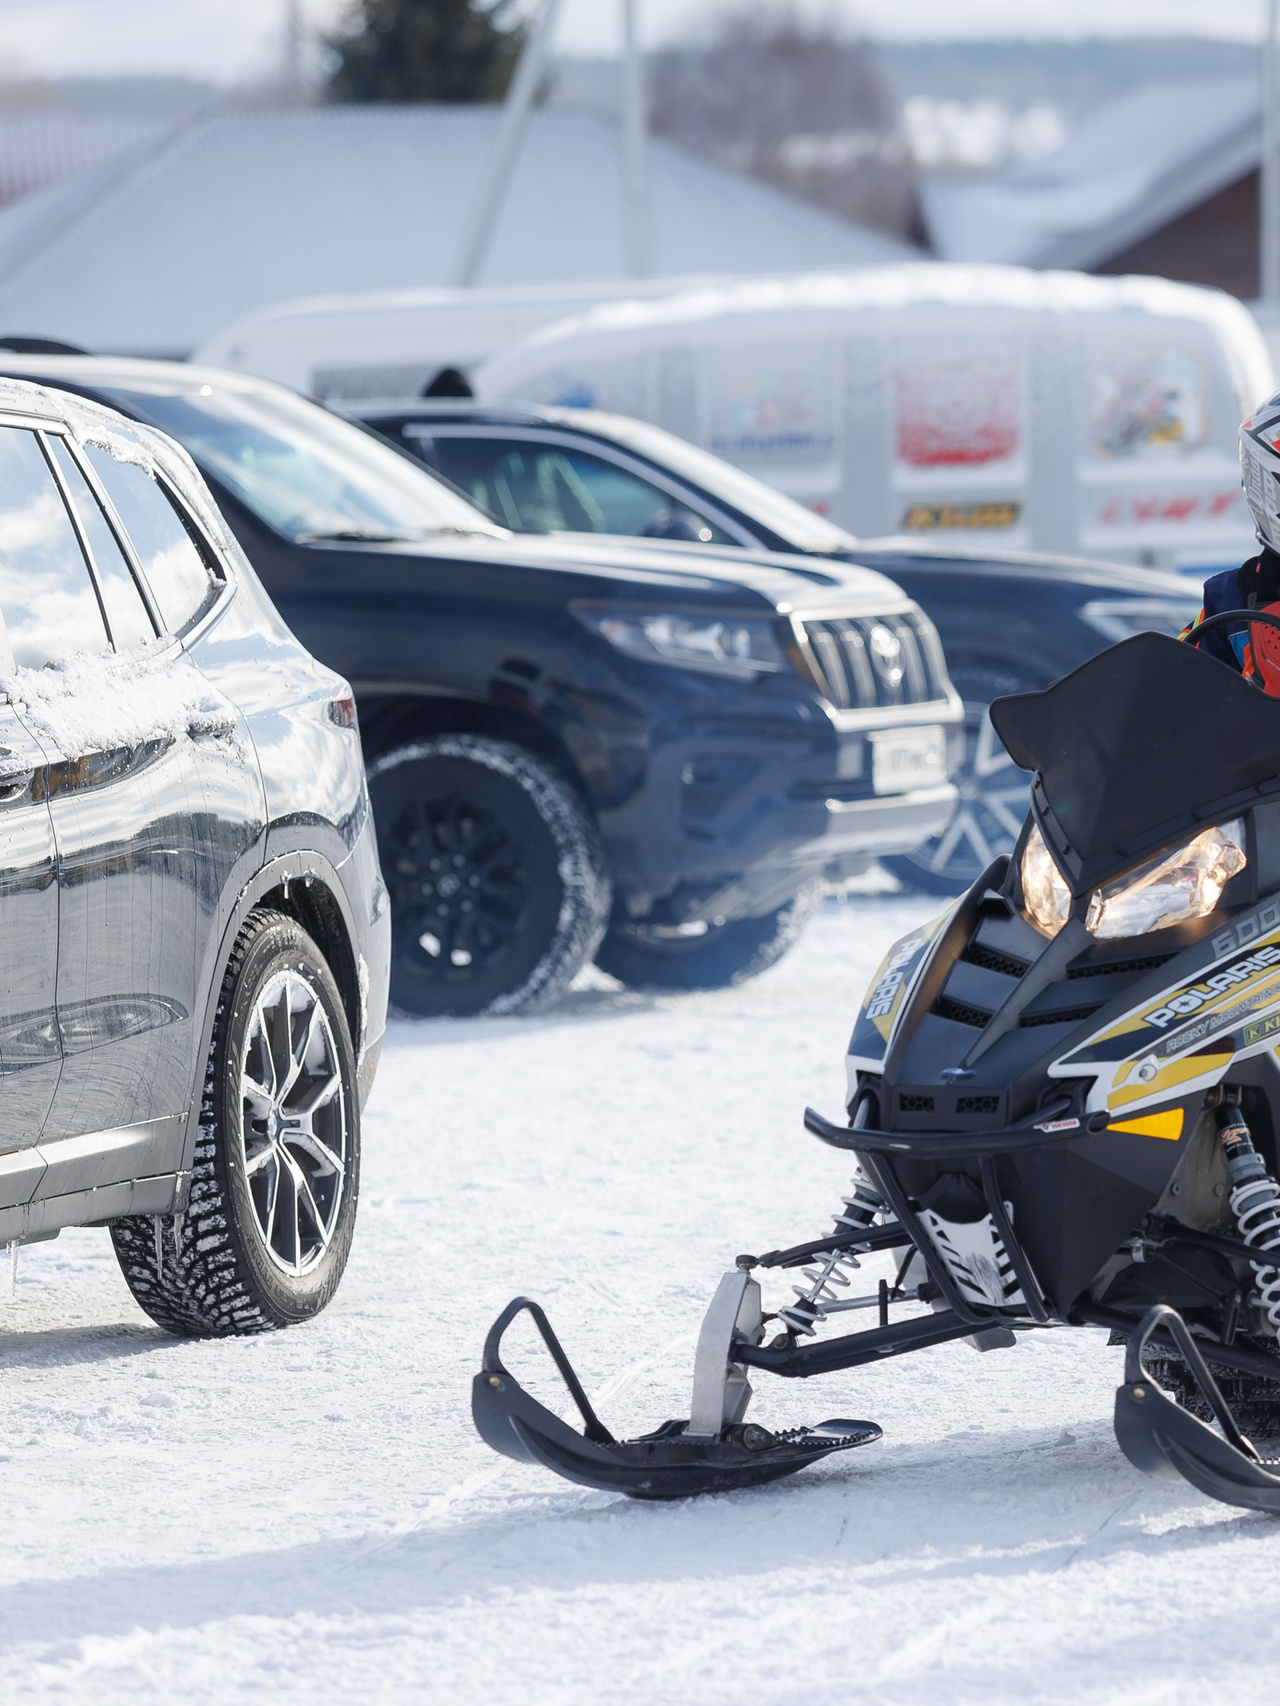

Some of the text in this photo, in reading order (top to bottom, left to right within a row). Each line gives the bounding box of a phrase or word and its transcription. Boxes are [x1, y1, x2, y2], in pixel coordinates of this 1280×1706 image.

[1212, 901, 1280, 958] 600
[865, 937, 923, 1020] POLARIS
[1166, 1017, 1212, 1053] ROCKY
[1209, 986, 1273, 1031] MOUNTAIN
